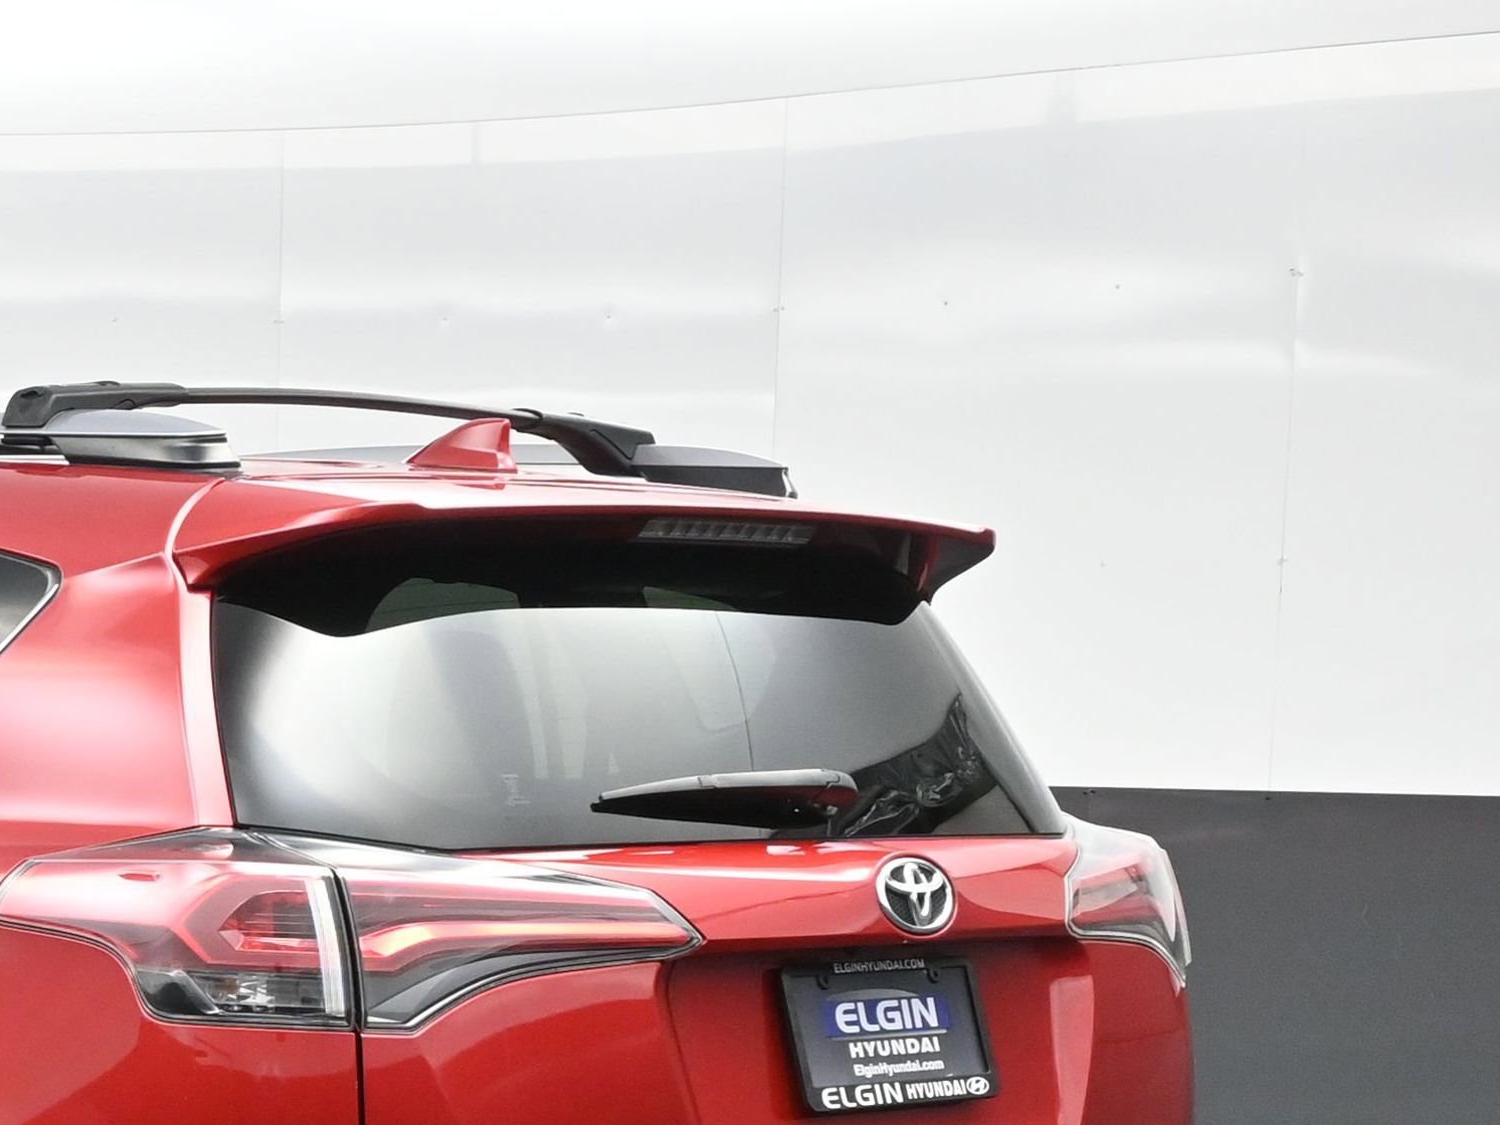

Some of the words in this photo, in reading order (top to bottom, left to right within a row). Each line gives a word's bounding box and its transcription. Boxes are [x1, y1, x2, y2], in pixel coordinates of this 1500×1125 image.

[833, 958, 925, 974] ELGINHYUNDAI.COM
[835, 997, 939, 1034] ELGIN
[849, 1036, 941, 1059] HYUNDAI
[853, 1059, 945, 1078] ElginHyundai.com
[821, 1082, 904, 1110] ELGIN
[905, 1079, 967, 1100] HYUNDAI
